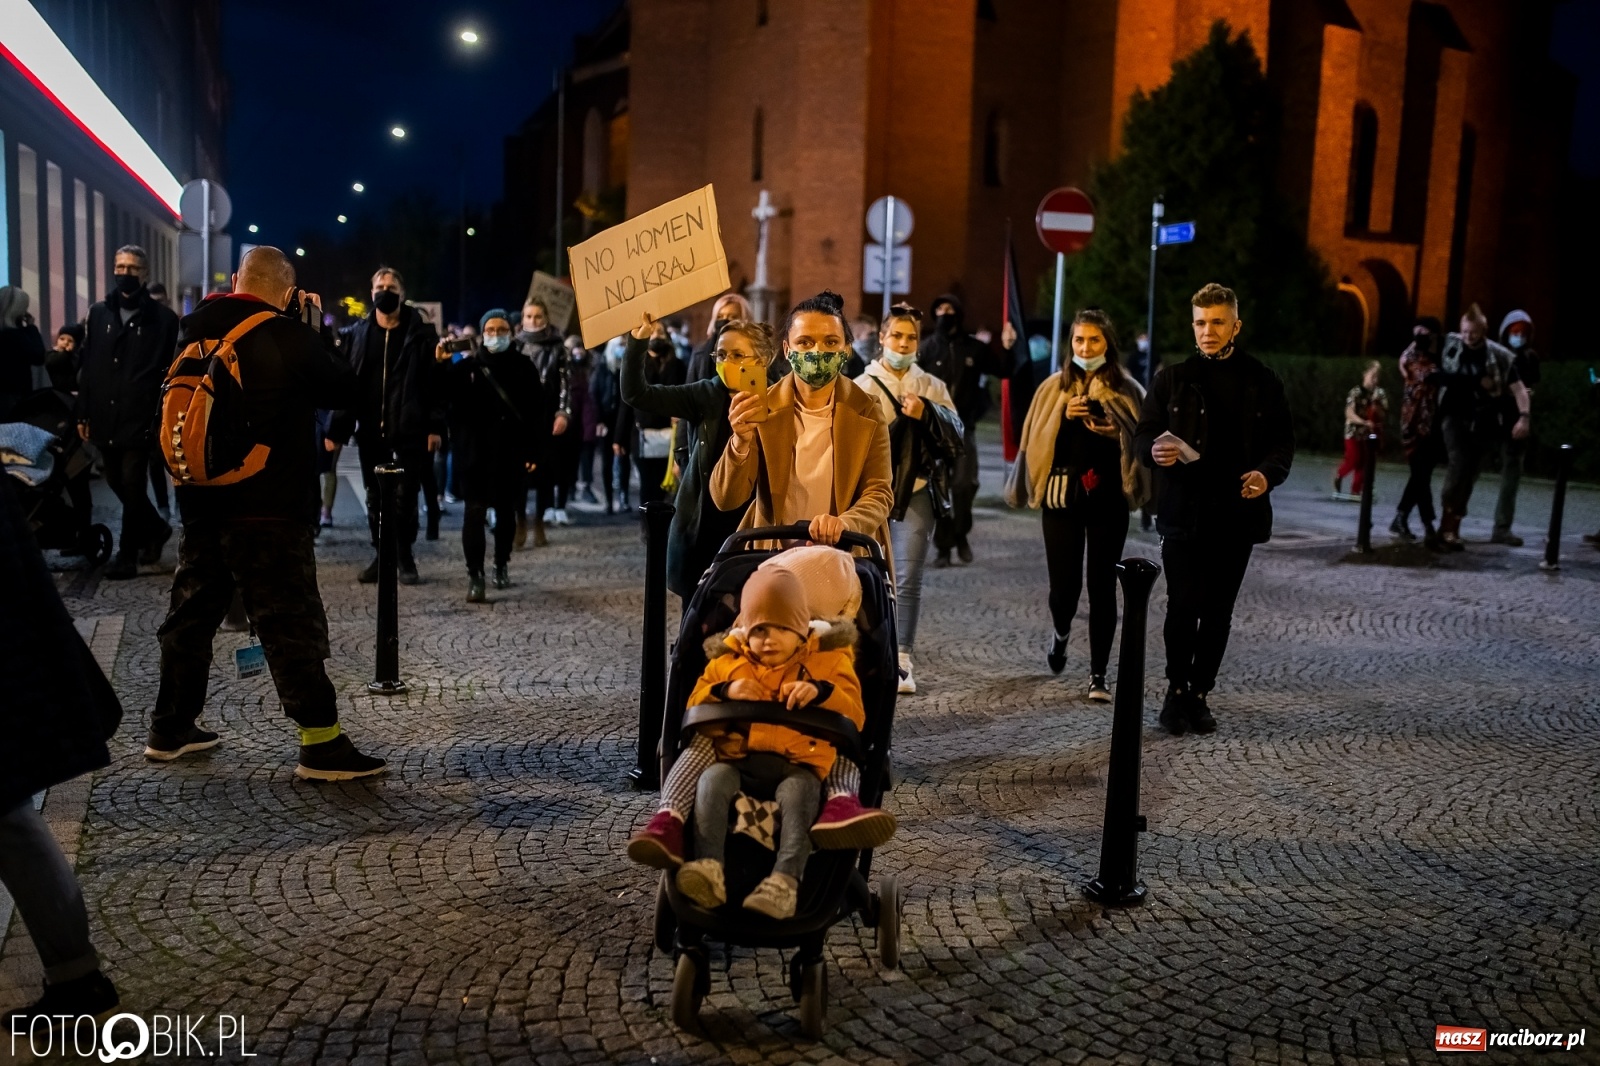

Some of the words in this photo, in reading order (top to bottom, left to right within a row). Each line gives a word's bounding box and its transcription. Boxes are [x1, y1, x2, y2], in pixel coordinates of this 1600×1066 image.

[584, 247, 615, 280] NO
[625, 205, 704, 260] WOMEN
[604, 275, 636, 310] NO
[640, 247, 696, 293] KRAJ
